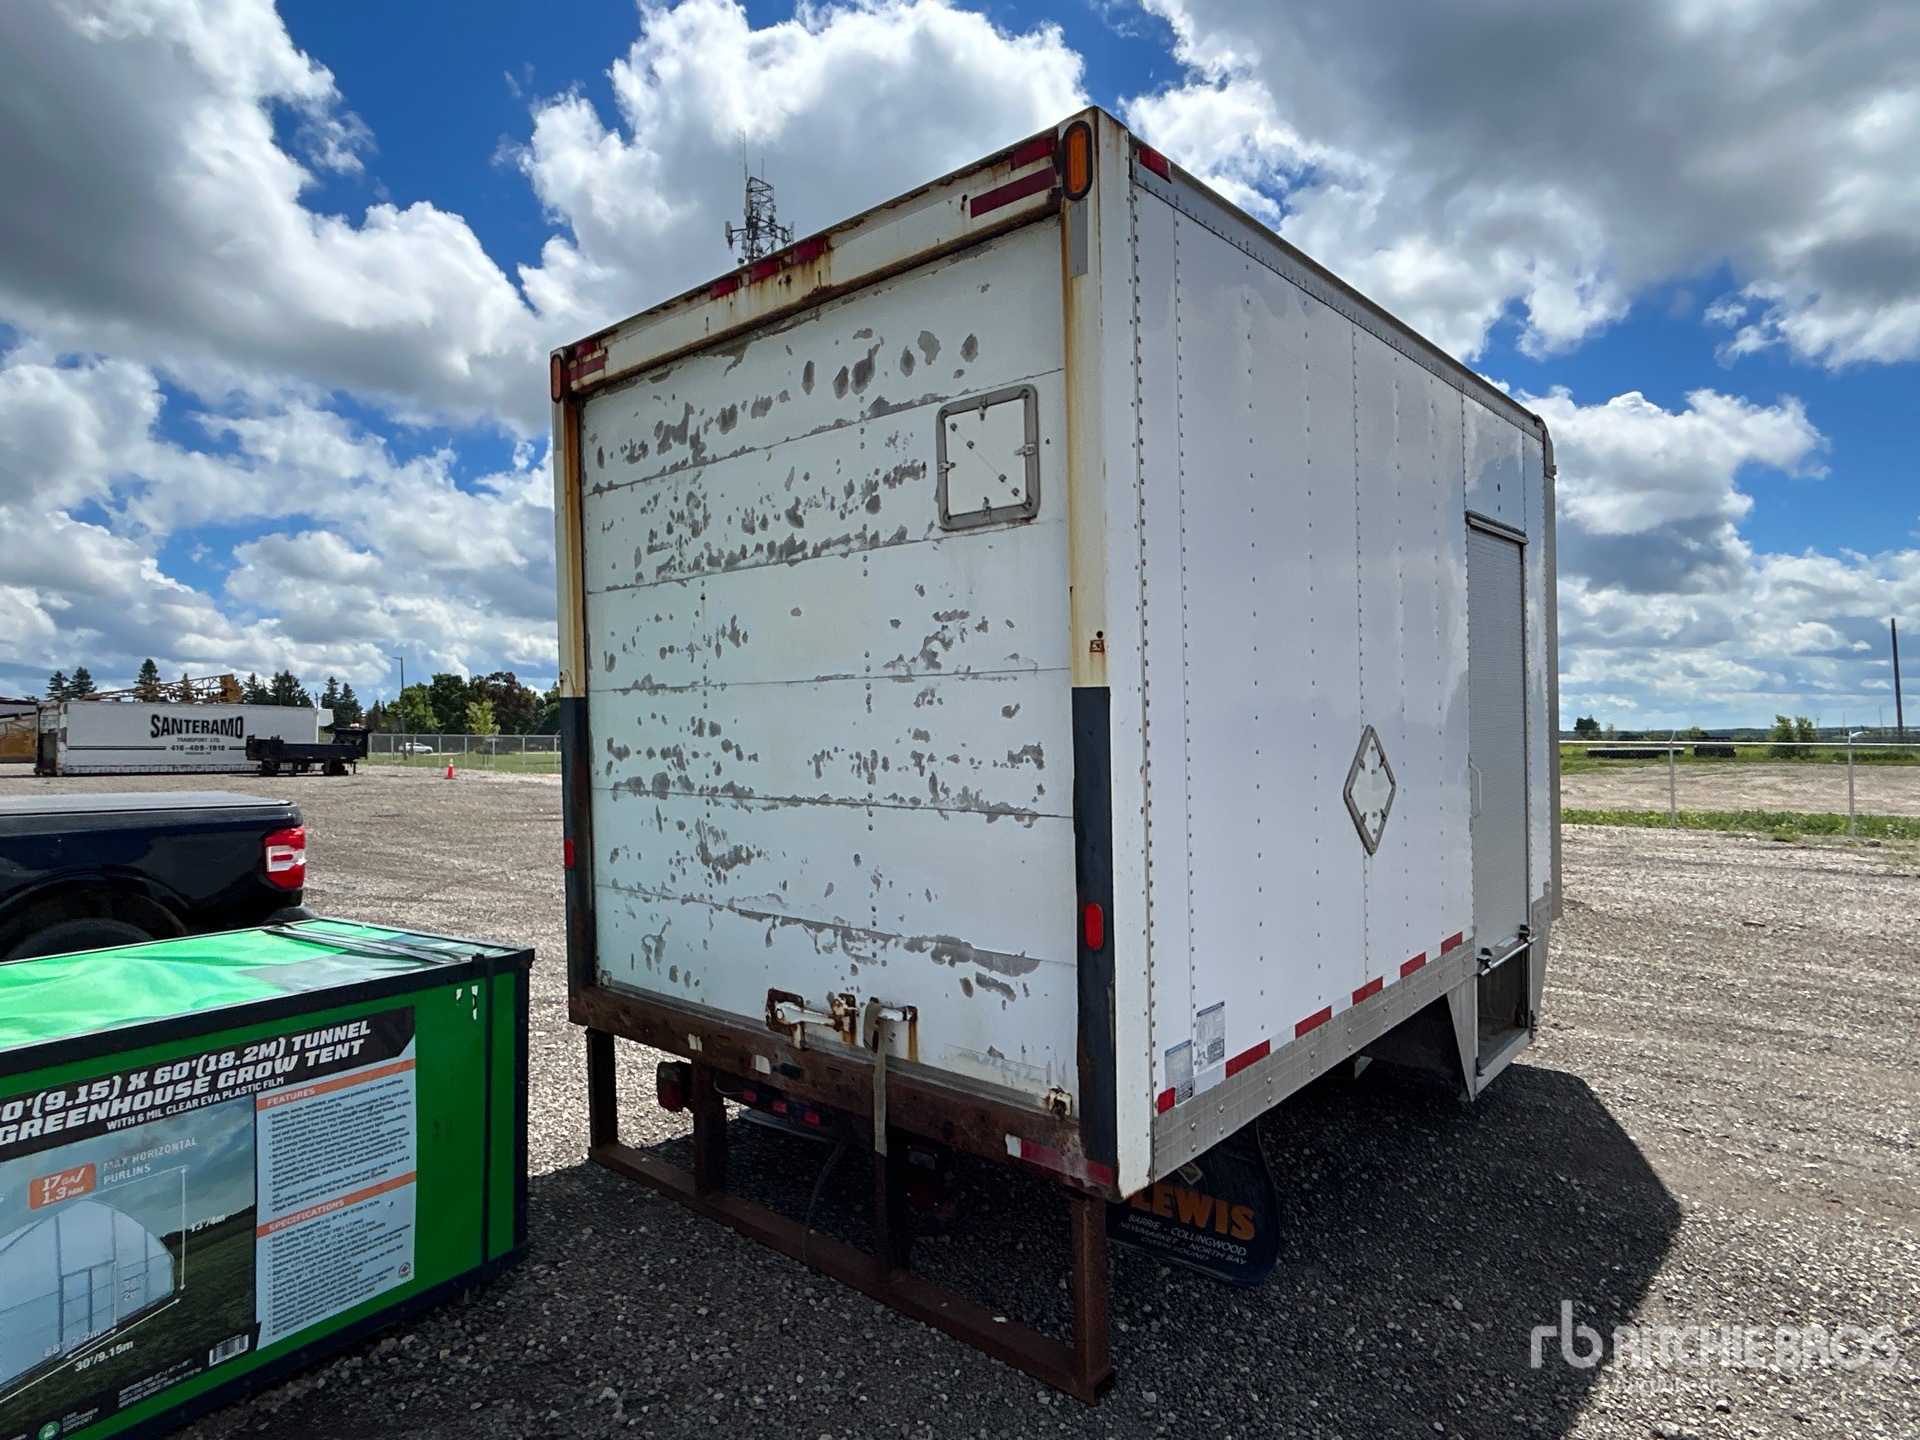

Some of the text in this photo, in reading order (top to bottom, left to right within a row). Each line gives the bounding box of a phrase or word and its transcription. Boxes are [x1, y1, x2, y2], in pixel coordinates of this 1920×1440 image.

[150, 714, 244, 739] SANTERAMO
[0, 1075, 122, 1123] 0'(9.15)
[127, 1071, 149, 1092] X
[292, 1020, 371, 1052] TUNNEL
[0, 1038, 365, 1146] GREENHOUSE GROW TENT
[106, 1076, 285, 1131] WITH 6 MIL CLEAR EVA PLASTIC FILM
[267, 1087, 316, 1107] FEATURES
[131, 1137, 198, 1164] HORIZONTAL
[103, 1163, 152, 1186] PURLINS
[268, 1199, 345, 1233] SPECIFICATIONS
[1128, 1213, 1248, 1257] BARRIE COLLINGWOOD
[1119, 1221, 1248, 1266] NEWMARKET NORTH BAY
